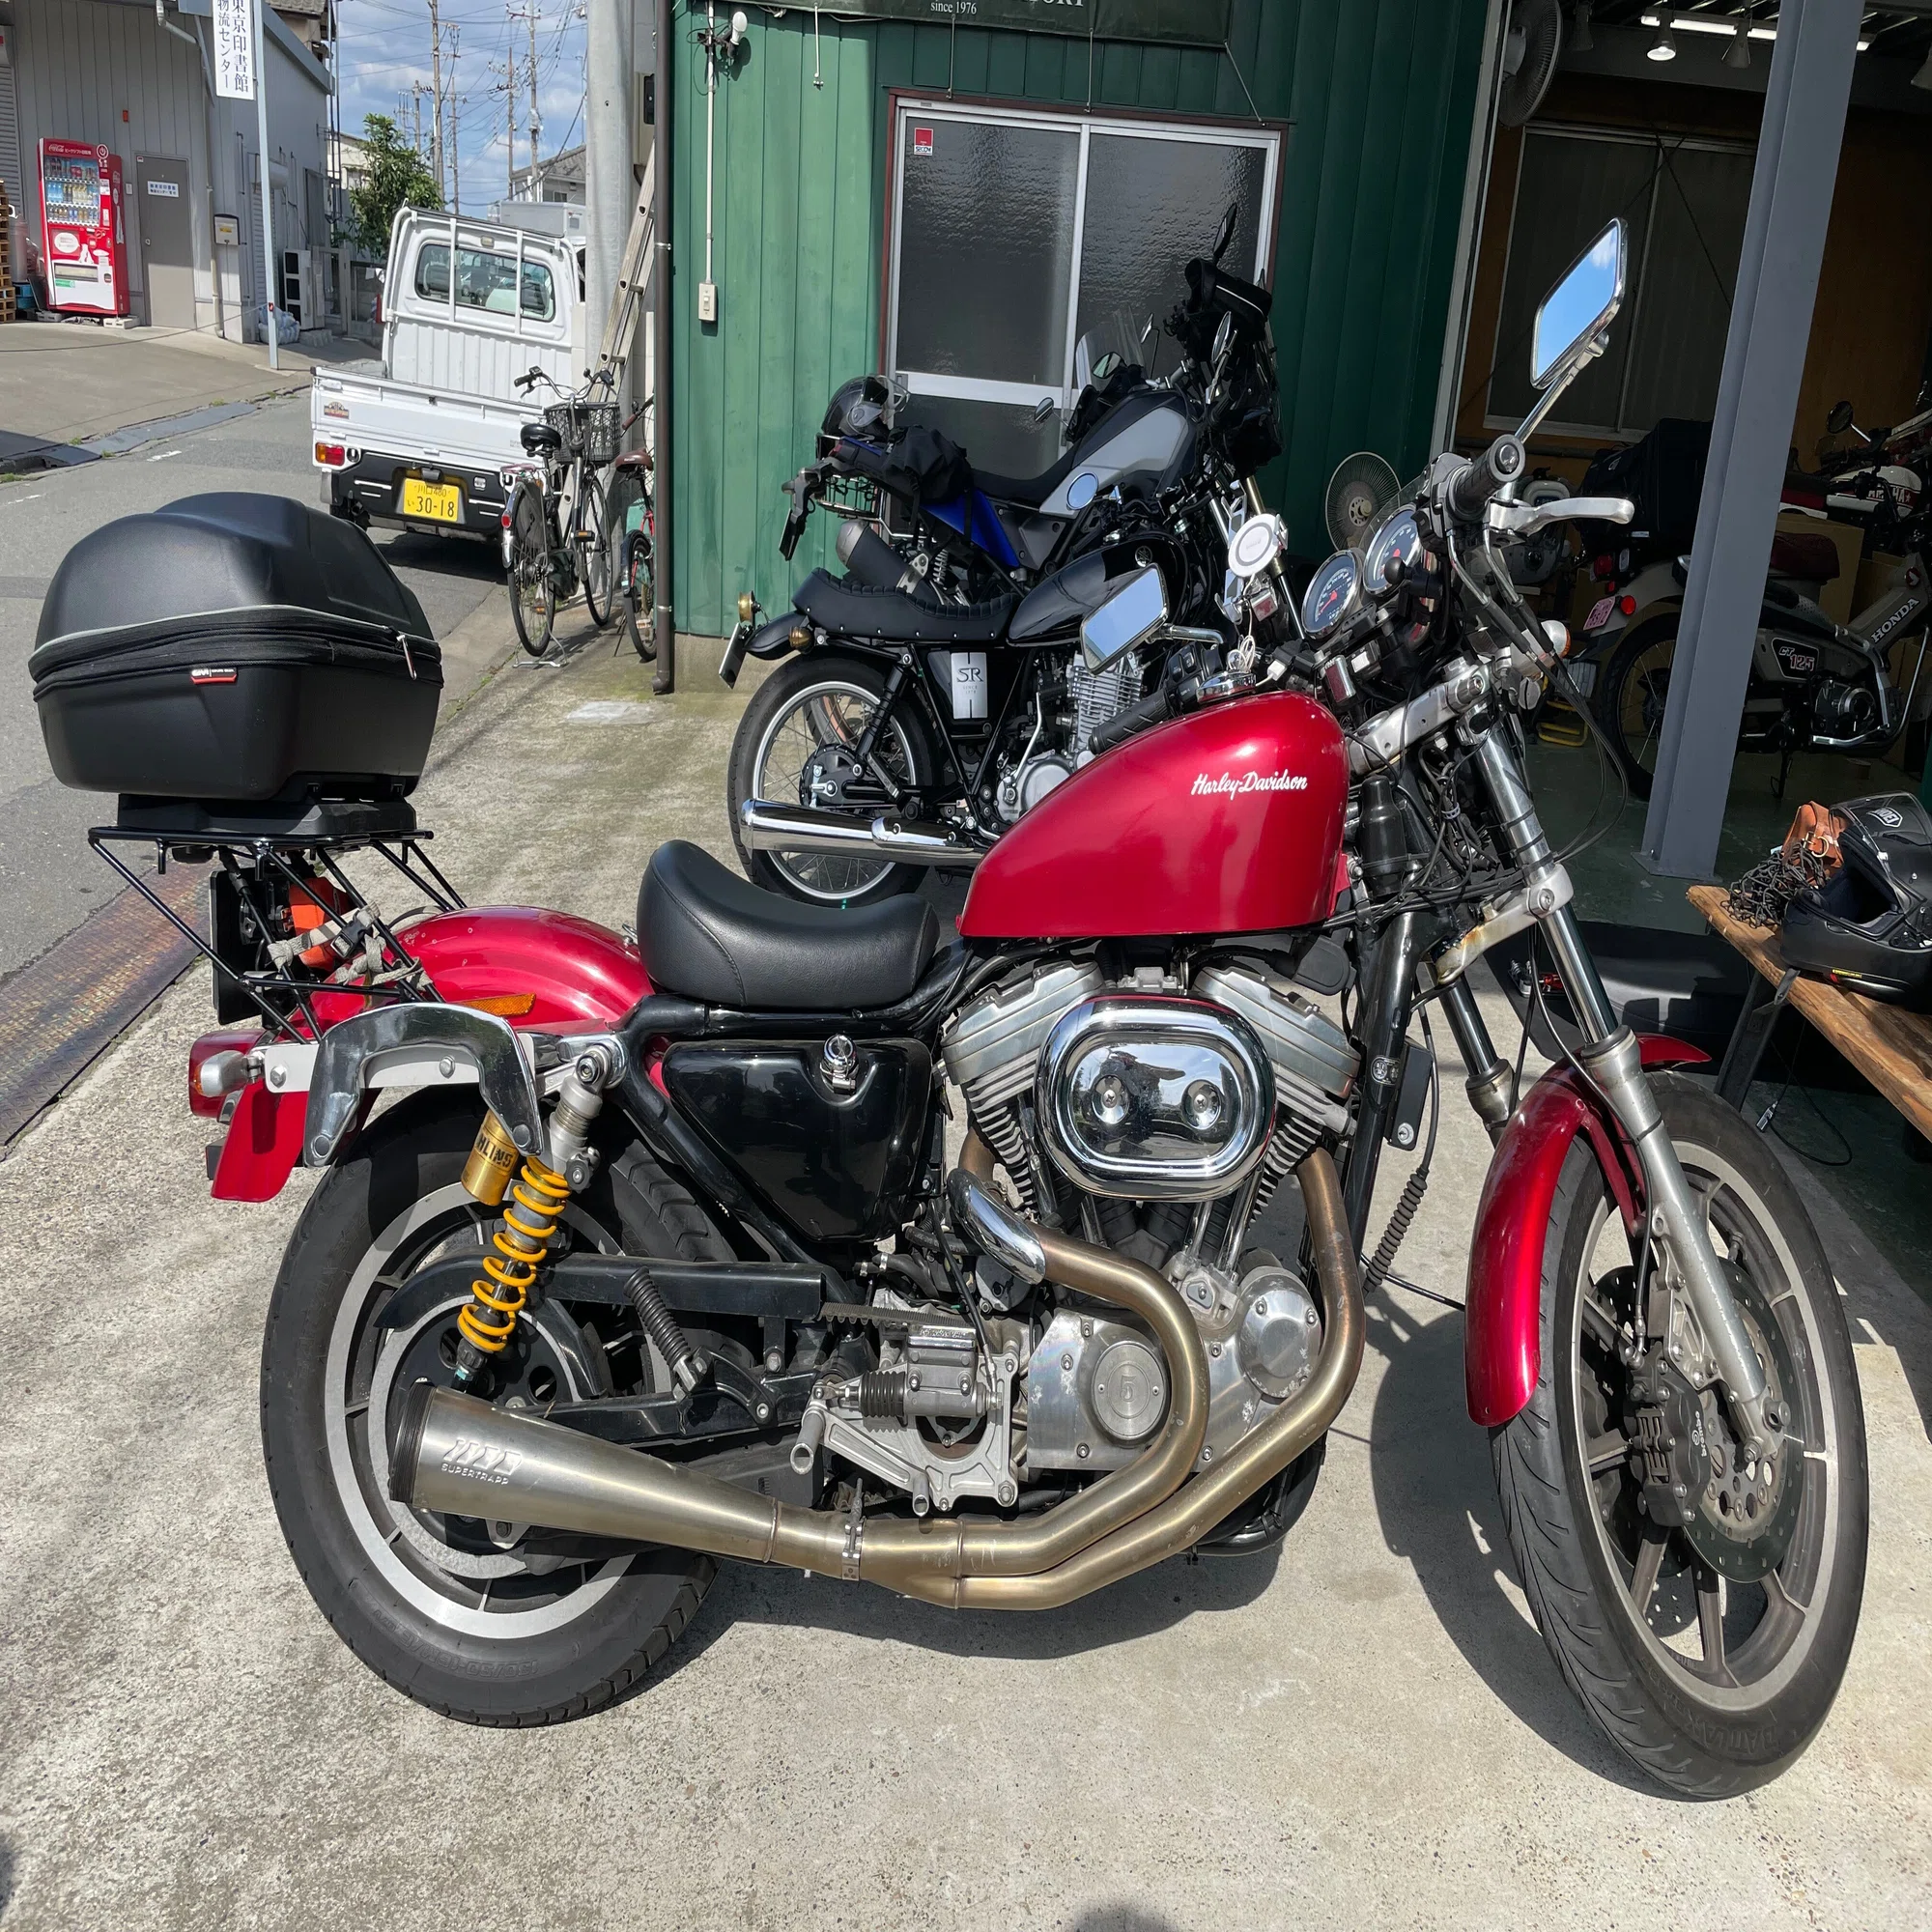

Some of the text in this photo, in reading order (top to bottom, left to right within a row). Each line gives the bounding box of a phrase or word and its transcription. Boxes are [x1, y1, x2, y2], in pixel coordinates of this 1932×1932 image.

[930, 2, 977, 14] since 1976
[217, 0, 231, 89] 物流センター
[232, 0, 248, 93] 東京印書館
[416, 496, 454, 517] 30-18
[1871, 597, 1920, 643] HONDA
[1778, 646, 1795, 657] CT
[1790, 654, 1815, 671] 125
[956, 668, 983, 682] SR
[1190, 769, 1308, 800] Harley-Davidson
[476, 1132, 513, 1168] HLINS
[1119, 1375, 1136, 1401] 5
[1695, 1410, 1707, 1457] brembo
[441, 1463, 510, 1485] SUPERTRAPP
